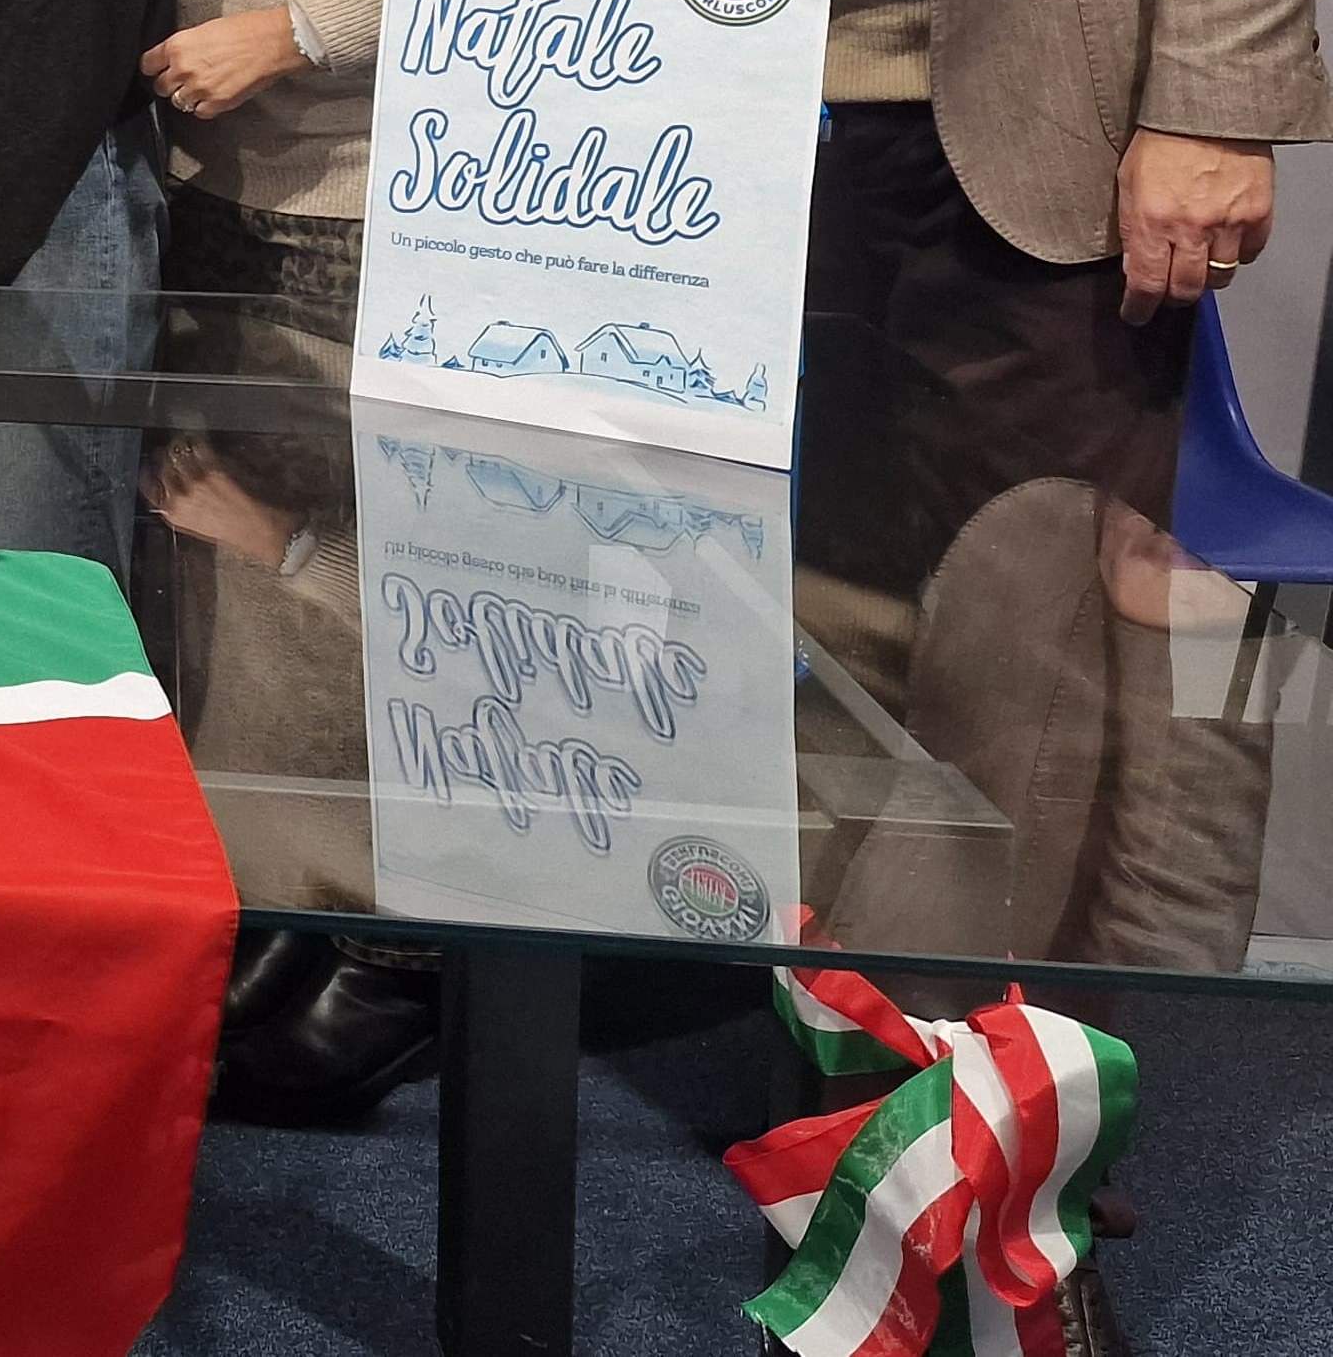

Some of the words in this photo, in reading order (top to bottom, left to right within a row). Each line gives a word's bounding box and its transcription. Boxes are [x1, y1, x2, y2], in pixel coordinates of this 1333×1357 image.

[388, 109, 721, 245] Solidale
[391, 231, 412, 247] Un
[415, 235, 466, 255] piccolo
[469, 244, 512, 260] gesto
[515, 249, 542, 265] che
[545, 253, 575, 271] può
[577, 258, 609, 274] fare
[612, 261, 624, 276] la
[629, 264, 709, 288] differenza
